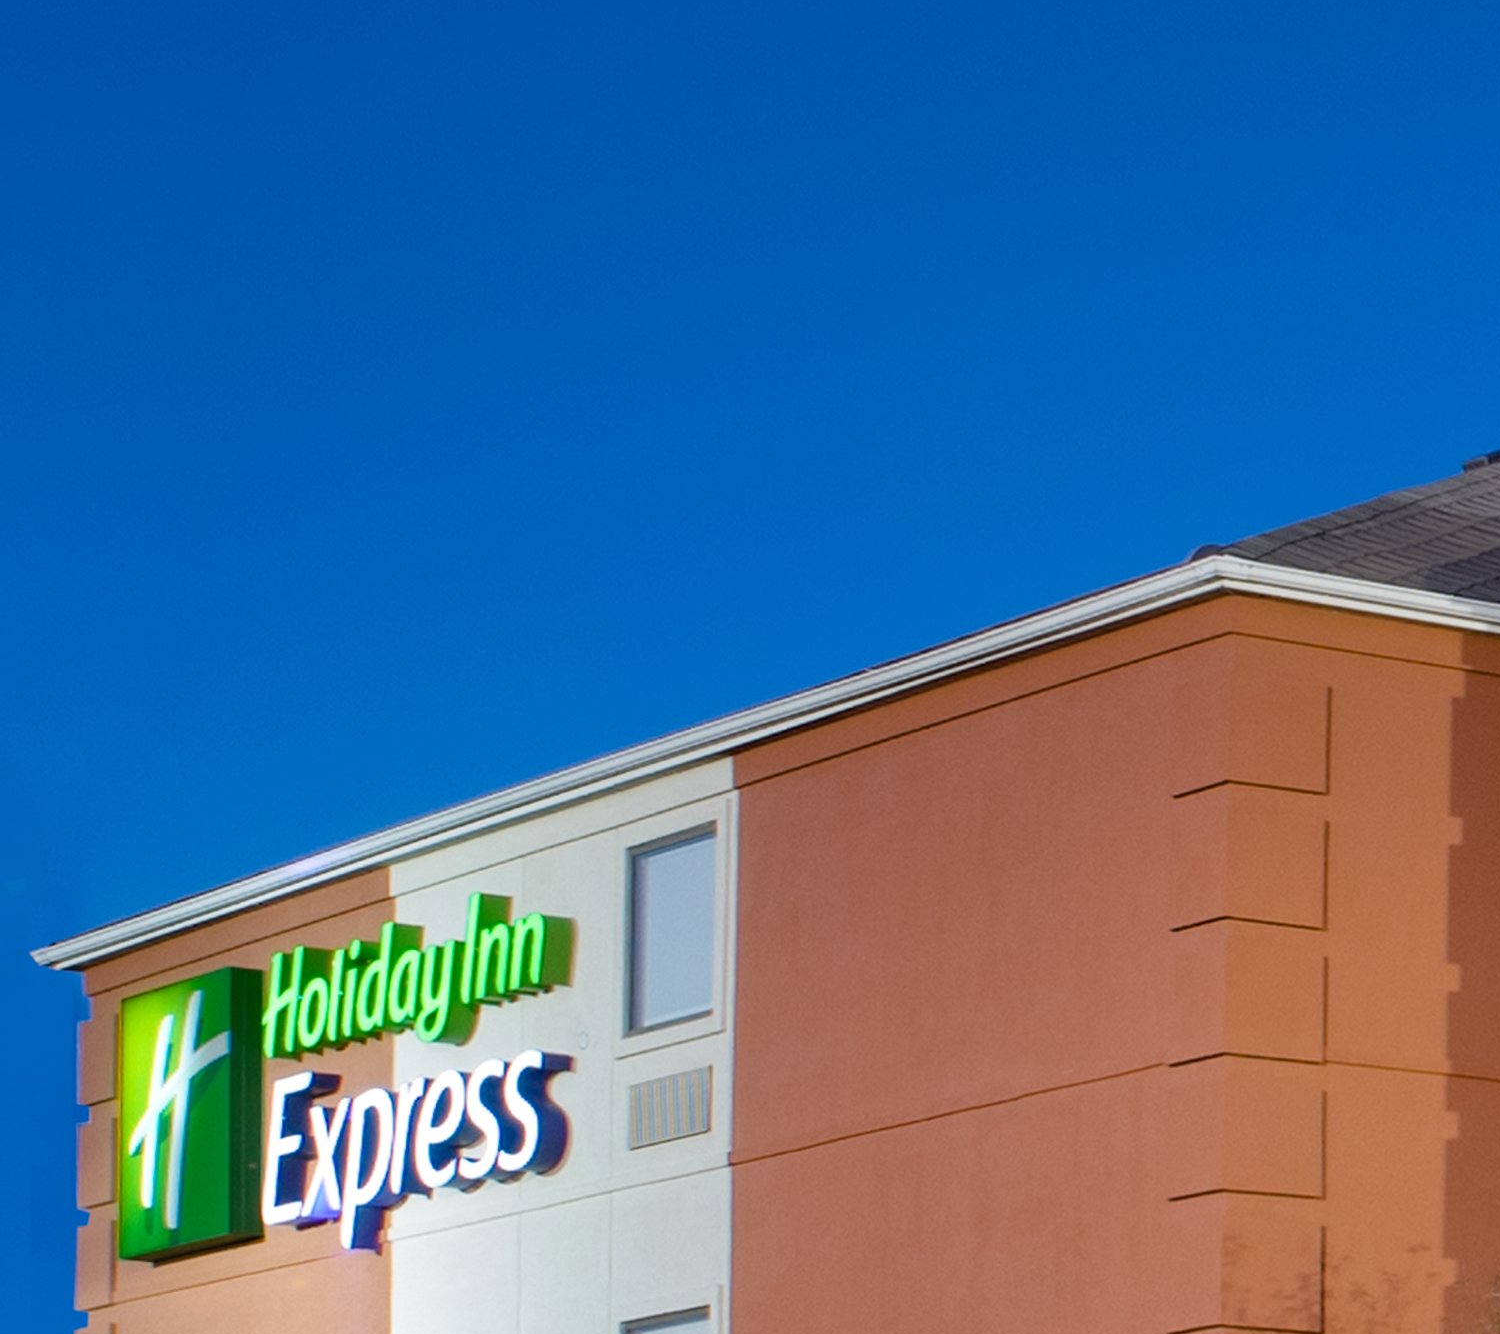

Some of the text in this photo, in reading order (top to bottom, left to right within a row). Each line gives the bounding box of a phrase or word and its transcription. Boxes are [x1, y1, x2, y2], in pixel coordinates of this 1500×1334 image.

[262, 891, 553, 1059] Holiday Inn
[261, 1049, 552, 1250] Express
